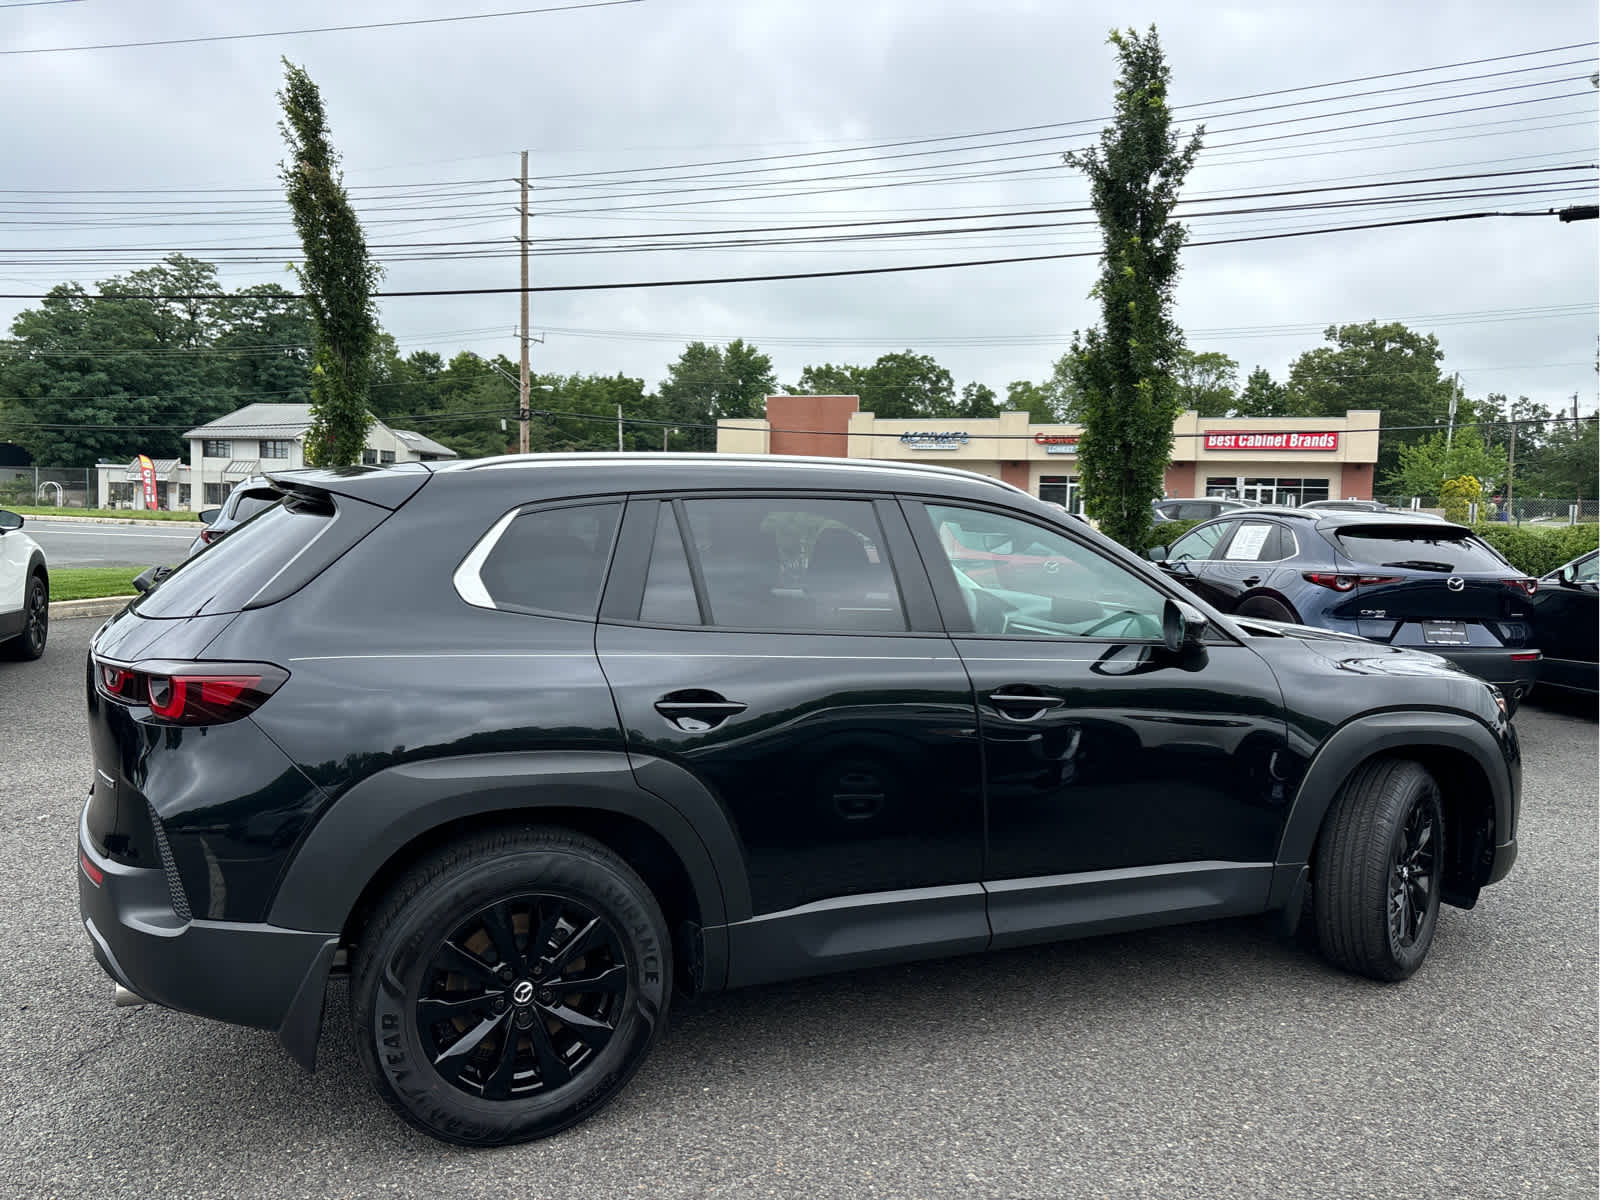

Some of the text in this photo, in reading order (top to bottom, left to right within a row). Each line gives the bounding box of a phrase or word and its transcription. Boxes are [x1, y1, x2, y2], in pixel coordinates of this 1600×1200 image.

[1208, 432, 1335, 448] Best Cabinet Brands
